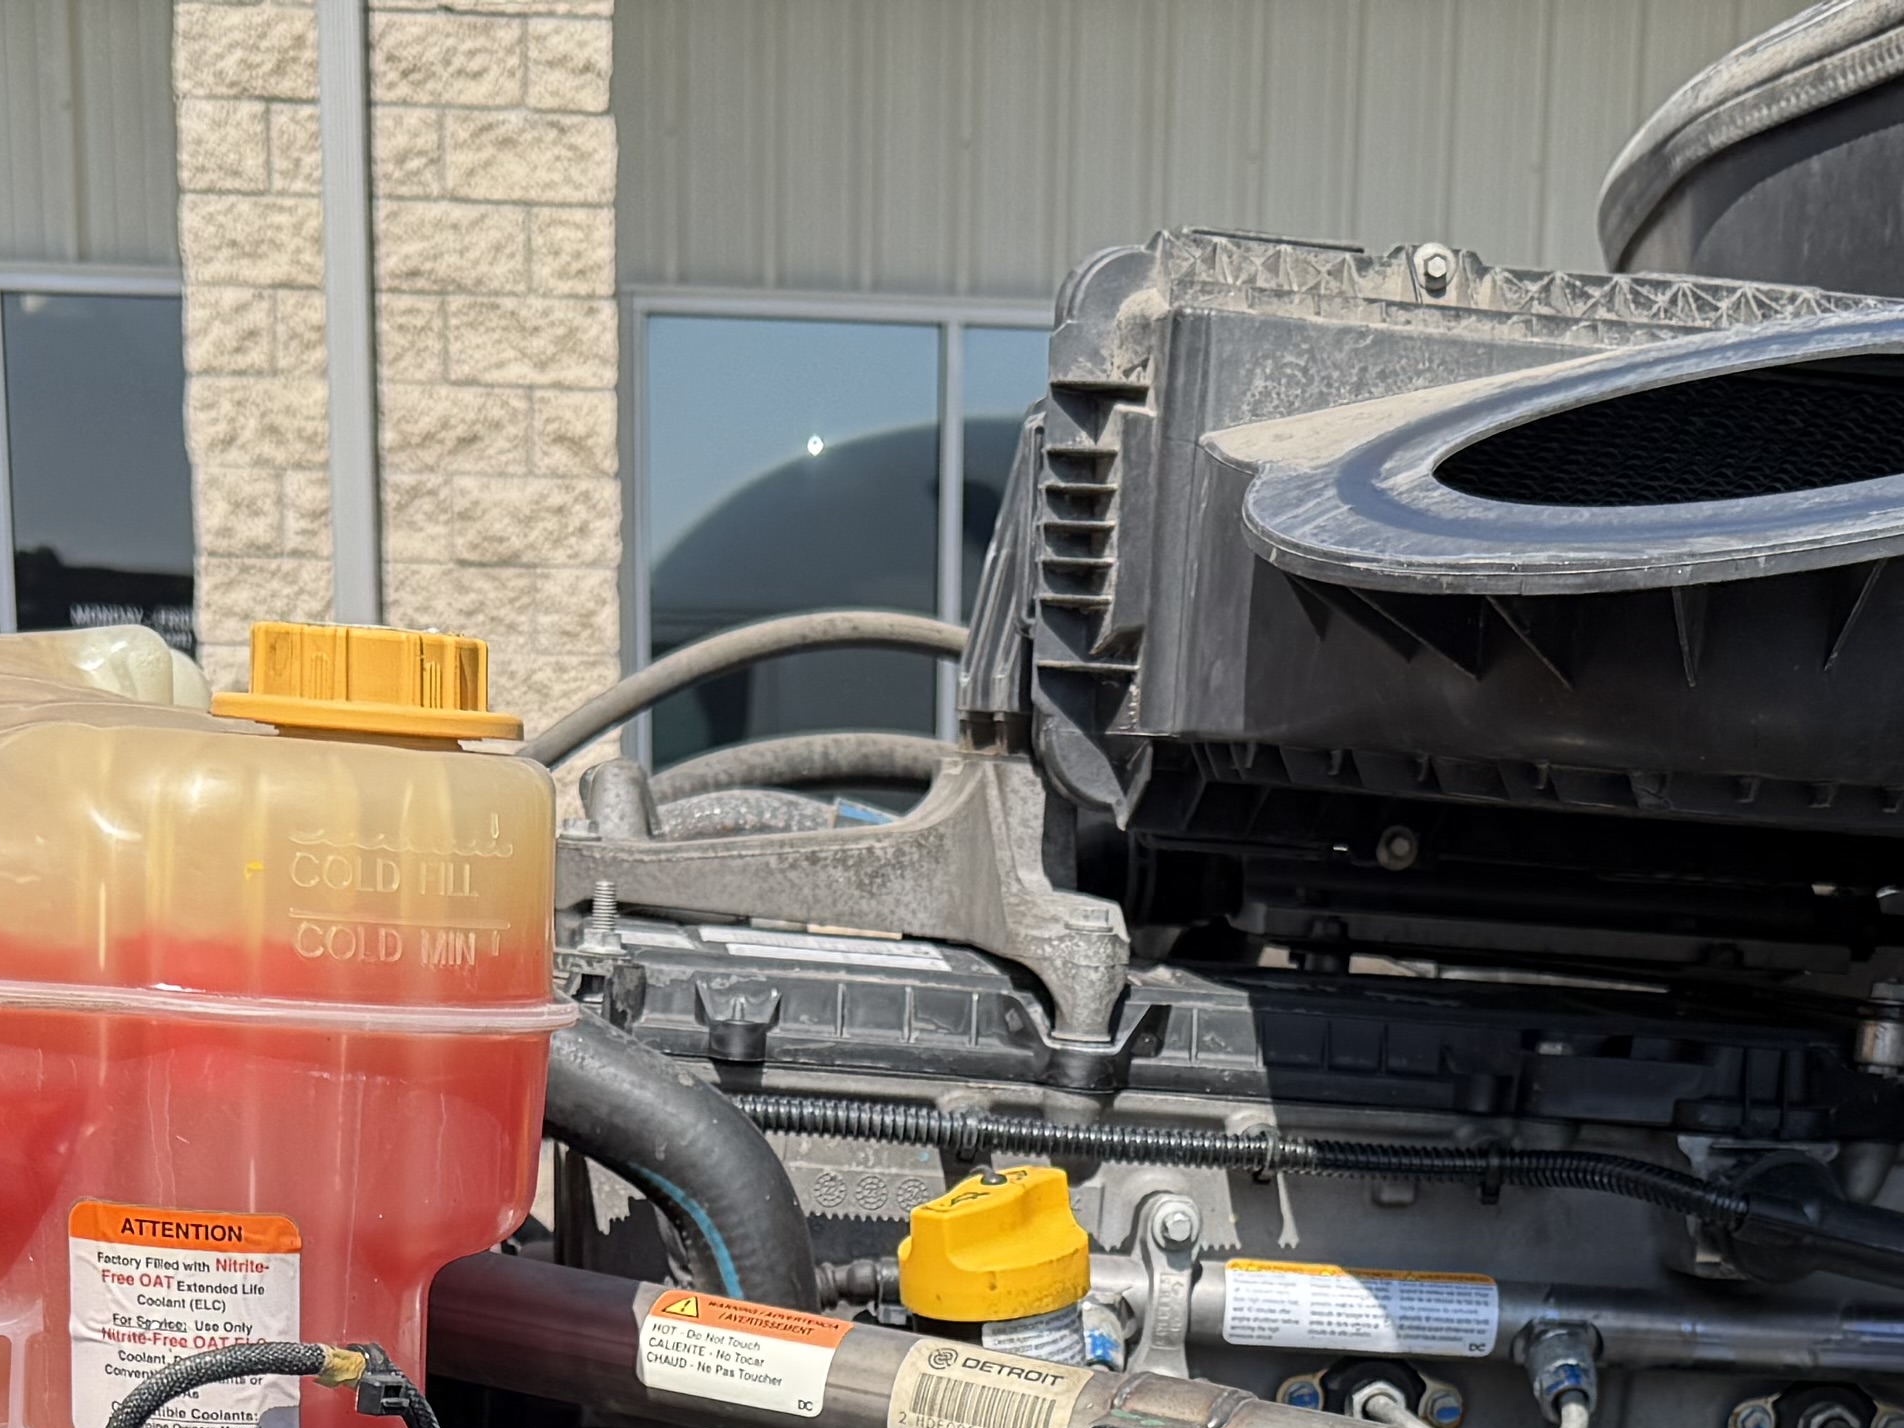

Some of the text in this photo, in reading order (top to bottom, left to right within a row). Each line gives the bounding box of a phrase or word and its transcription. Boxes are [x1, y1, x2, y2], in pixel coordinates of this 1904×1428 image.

[290, 852, 480, 897] COLD FILL
[295, 921, 477, 966] COLD MIN
[121, 1218, 243, 1242] ATTENTION
[97, 1252, 270, 1274] Factory Filled with Nitrite-
[102, 1270, 265, 1296] Free OAT Extended Life
[137, 1294, 226, 1313] Coolant (ELC)
[113, 1313, 253, 1335] For Use Only
[102, 1328, 187, 1348] Nitrite-Free
[193, 1335, 230, 1350] OAT
[652, 1323, 761, 1351] HOT Do Not Touch
[1469, 1343, 1486, 1352] DC
[118, 1350, 166, 1364] Coolant
[649, 1337, 765, 1368] CALIENTE No Tocar
[646, 1351, 783, 1386] CHAUD Ne Pas Toucher
[962, 1357, 1064, 1386] DETROIT
[191, 1409, 258, 1422] Coolants:
[797, 1400, 813, 1411] DC
[898, 1412, 907, 1425] 2
